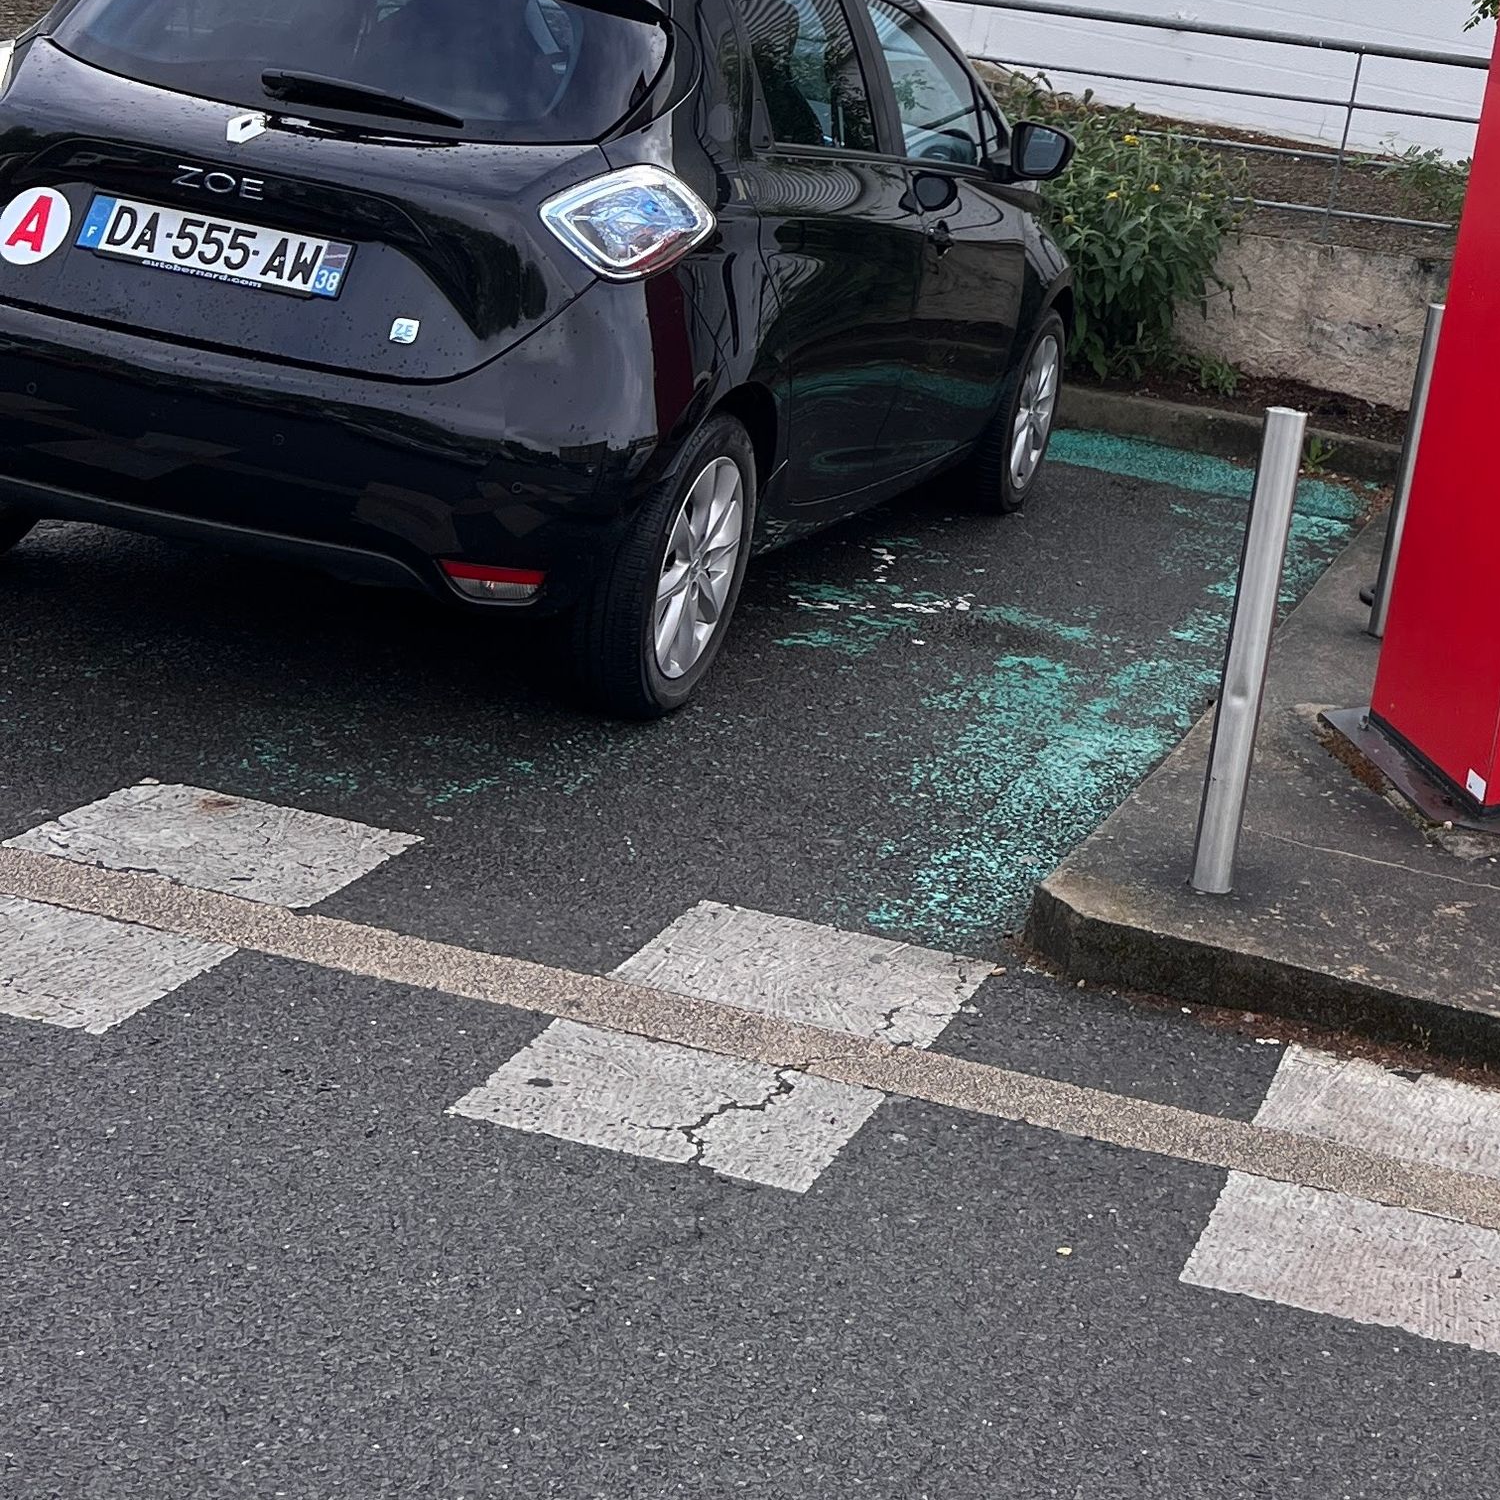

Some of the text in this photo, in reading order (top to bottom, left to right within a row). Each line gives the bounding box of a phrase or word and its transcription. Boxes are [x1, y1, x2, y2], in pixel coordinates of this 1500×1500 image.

[172, 164, 265, 201] ZOE
[5, 195, 54, 252] A
[86, 225, 97, 239] F
[105, 204, 324, 286] DA-555-AW
[142, 259, 262, 289] autobernard.com
[314, 269, 341, 292] 38
